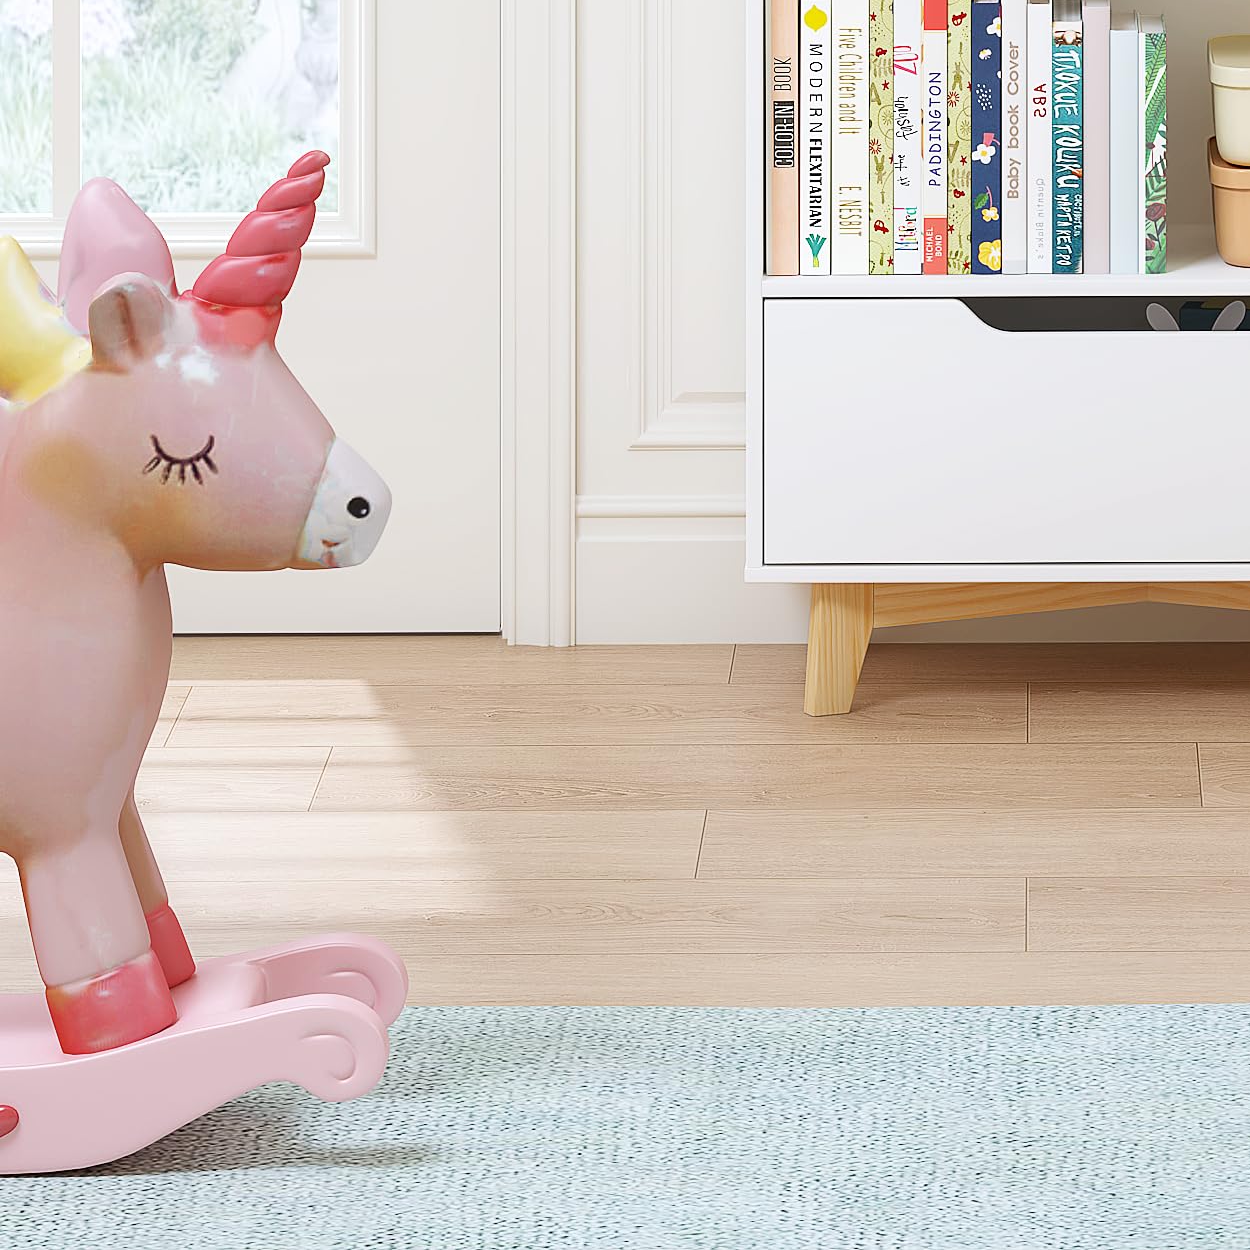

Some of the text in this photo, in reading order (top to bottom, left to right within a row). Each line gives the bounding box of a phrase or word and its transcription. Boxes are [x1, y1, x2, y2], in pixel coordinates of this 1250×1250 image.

[773, 57, 792, 91] BOOK
[838, 28, 863, 135] Five Children and It
[809, 44, 823, 228] MODERN FLEXITARIAN
[928, 72, 942, 187] PADDINGTON
[1007, 41, 1021, 199] Baby book Cover
[1052, 49, 1083, 189] ПЛОХИЕ КОШКИ
[894, 154, 906, 171] the
[897, 176, 910, 187] at
[838, 186, 862, 236] E. NESBIT
[893, 206, 918, 251] Mitford
[1054, 193, 1073, 266] МАРТА КЕТРО
[926, 226, 934, 262] MICHAEL
[935, 234, 943, 257] BOND
